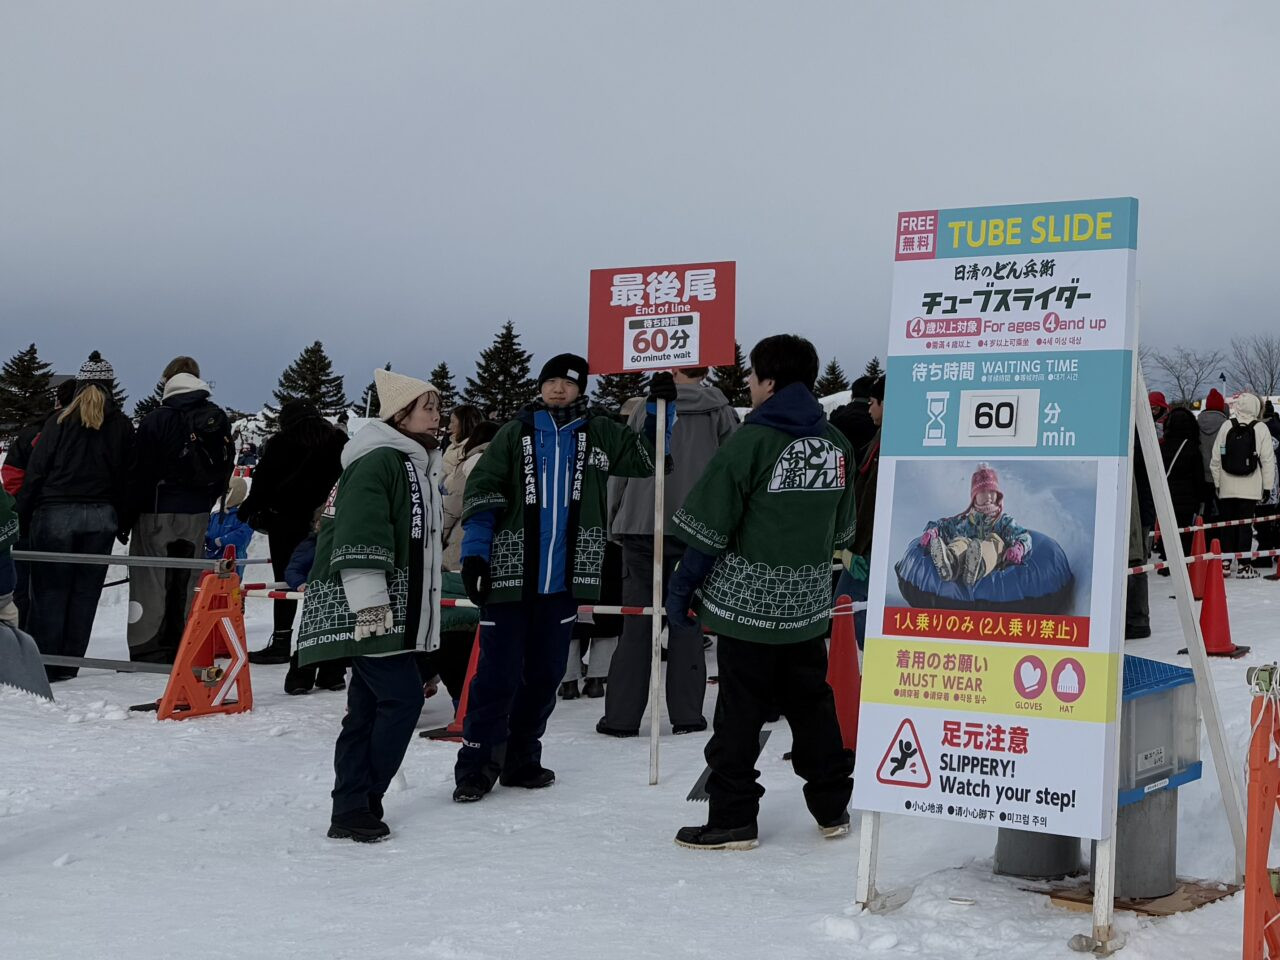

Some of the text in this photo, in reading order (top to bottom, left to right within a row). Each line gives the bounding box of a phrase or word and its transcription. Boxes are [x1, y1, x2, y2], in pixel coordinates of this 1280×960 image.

[900, 216, 935, 231] FREE
[948, 212, 1113, 248] TUBE SLIDE
[902, 235, 930, 251] 無料
[954, 258, 1056, 281] 日清のどん兵衛
[610, 269, 717, 307] 最後尾
[921, 277, 1091, 315] チューブスライダー
[635, 303, 691, 315] End of line
[643, 317, 679, 328] 待ち時間
[911, 318, 978, 336] 4歳以上対象
[984, 320, 1005, 333] For
[1008, 321, 1041, 334] ages
[1059, 316, 1085, 330] and
[1089, 318, 1106, 331] up
[632, 328, 690, 354] 60分
[631, 350, 691, 363] 60 minute wait
[982, 359, 1079, 374] WAITING TIME
[912, 362, 975, 382] 待ち時間
[974, 401, 1062, 429] 60 分
[1042, 426, 1076, 446] min
[522, 436, 537, 505] 日清のどん兵衛
[572, 432, 587, 501] 日清のどん兵衛
[737, 615, 777, 630] DONBEI
[778, 618, 810, 630] DONBEI
[896, 649, 989, 673] 着用のお願い
[899, 672, 983, 692] MUST WEAR
[1015, 701, 1043, 711] GLOVES
[1059, 704, 1075, 714] HAT
[941, 720, 1030, 755] 足元注意
[939, 753, 1016, 779] SLIPPERY!
[939, 774, 1077, 812] Watch your step!
[1007, 812, 1048, 828] 미끄럼 주의
